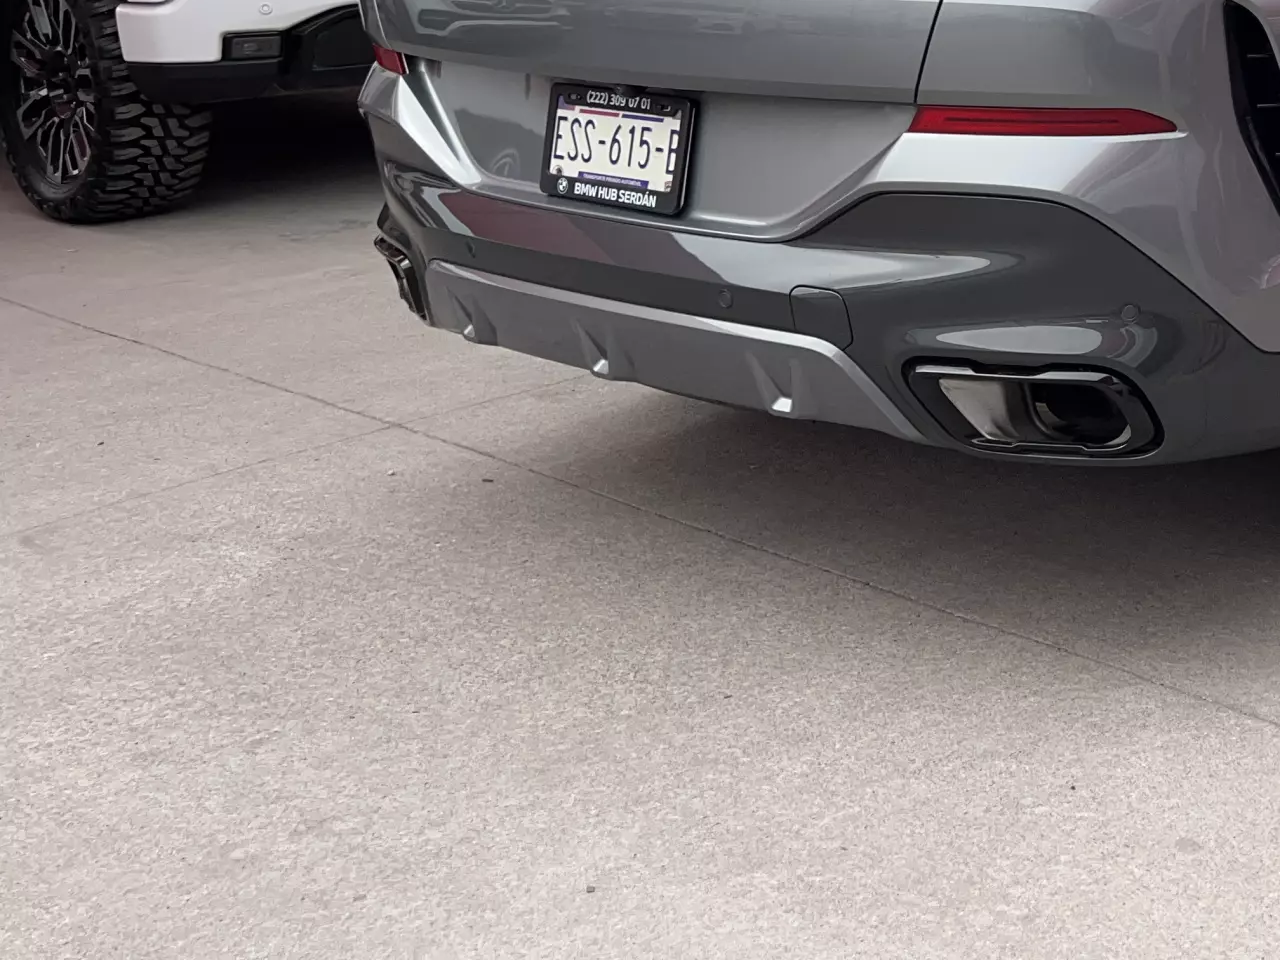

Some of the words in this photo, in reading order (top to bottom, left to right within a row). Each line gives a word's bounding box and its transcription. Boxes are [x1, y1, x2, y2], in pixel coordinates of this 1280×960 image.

[586, 90, 609, 106] (222)
[609, 93, 627, 107] 309
[640, 97, 651, 110] 01
[574, 182, 598, 197] BMW
[597, 186, 618, 201] HUB
[618, 190, 657, 208] SERDÁN
